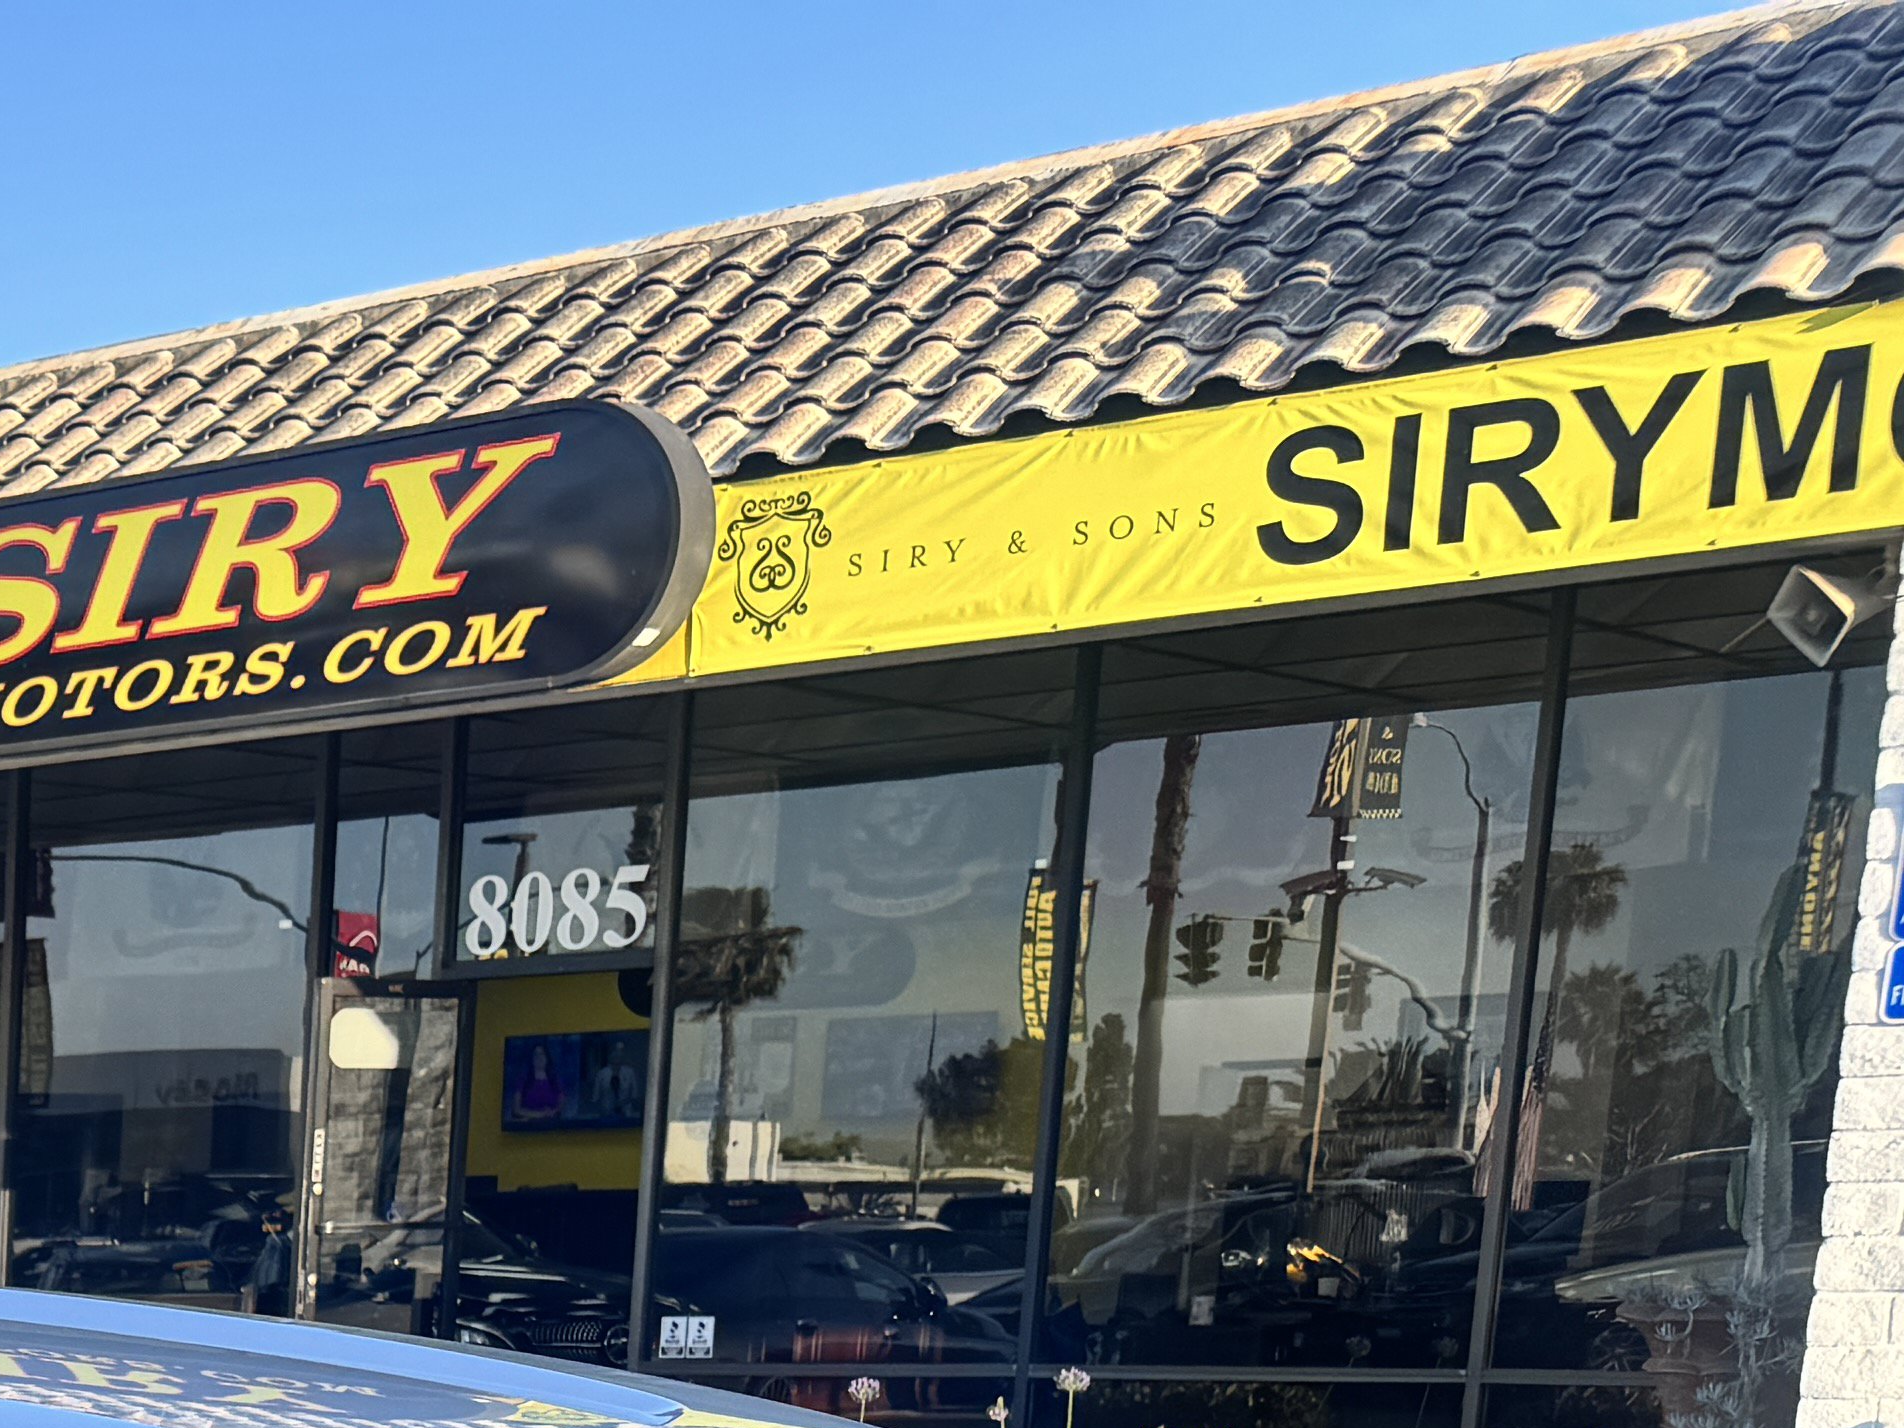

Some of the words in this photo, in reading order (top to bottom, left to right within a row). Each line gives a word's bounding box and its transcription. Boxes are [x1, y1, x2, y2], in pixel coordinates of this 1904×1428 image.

[1257, 342, 1904, 565] SIRYM
[847, 533, 968, 578] SIRY
[1006, 528, 1029, 556] &
[1072, 501, 1221, 547] SONS
[464, 864, 651, 957] 8085
